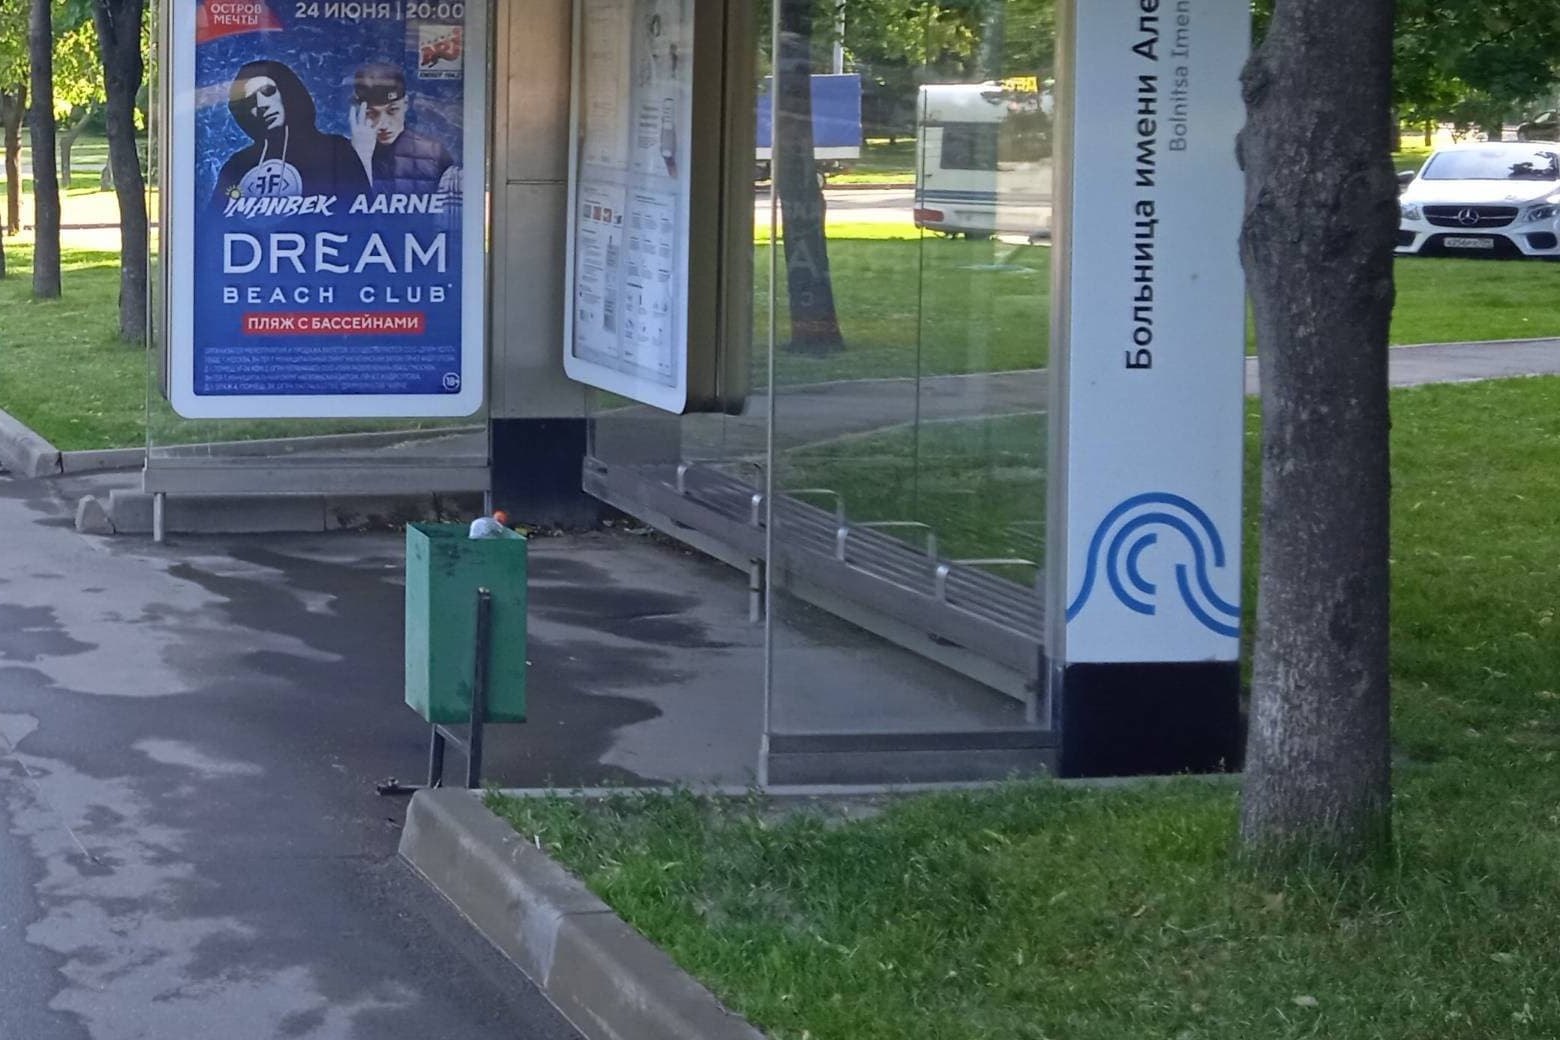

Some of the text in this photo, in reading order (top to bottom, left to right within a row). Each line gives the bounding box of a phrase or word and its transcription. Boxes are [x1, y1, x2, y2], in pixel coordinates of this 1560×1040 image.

[210, 3, 262, 15] ОСТРОВ
[295, 2, 465, 20] 24 ИЮНЯ 20:00
[213, 15, 259, 25] МЕЧТЫ
[1169, 64, 1189, 152] Bolnitsa
[1136, 74, 1158, 187] имени
[348, 192, 447, 215] AARNE
[223, 231, 447, 275] DREAM
[223, 285, 446, 304] BEACH CLUB
[1125, 199, 1160, 370] Больница
[247, 313, 419, 331] ПЛЯЖ С БАССЕЙНАМИ
